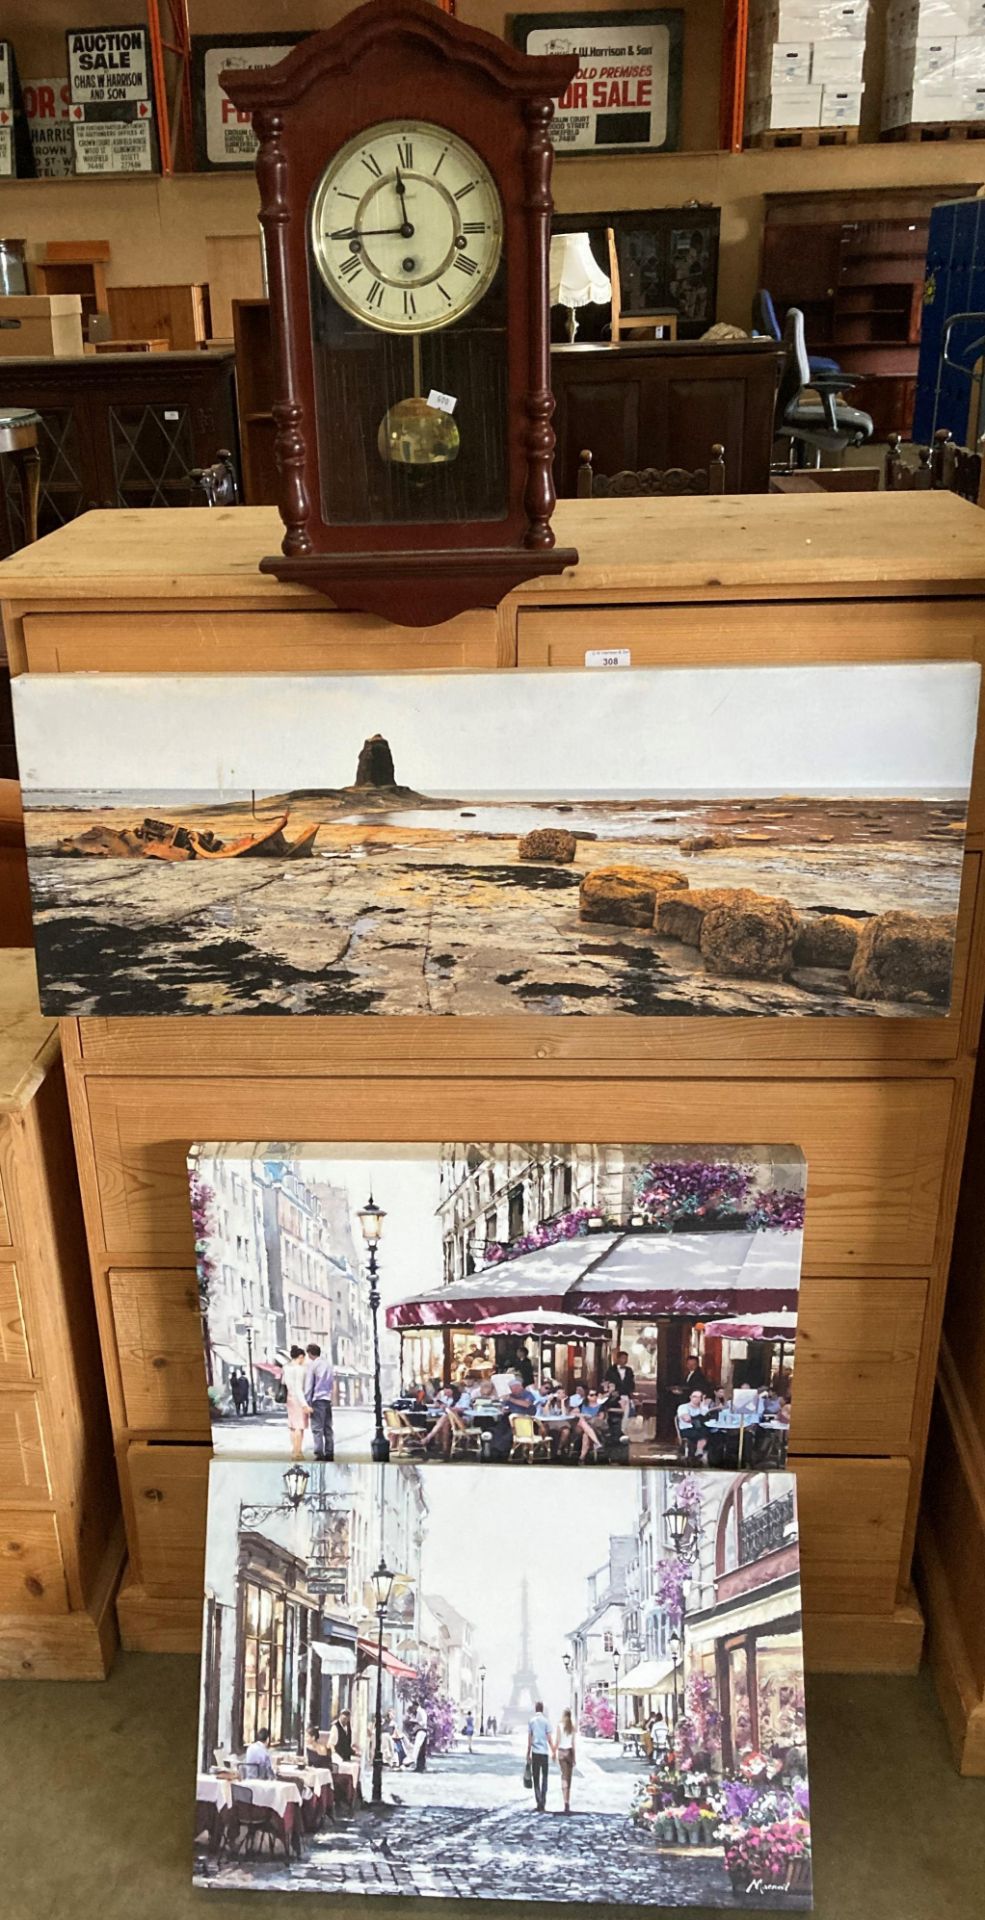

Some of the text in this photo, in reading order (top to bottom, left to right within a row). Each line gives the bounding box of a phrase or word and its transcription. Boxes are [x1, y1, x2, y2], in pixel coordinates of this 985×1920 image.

[73, 32, 142, 53] AUCTION
[628, 46, 634, 55] &
[636, 45, 653, 55] Son
[79, 52, 131, 70] SALE
[575, 65, 653, 79] OLD PREMISES
[106, 72, 143, 88] HARRISON
[23, 84, 55, 118] OR
[91, 88, 126, 100] AND SON
[558, 79, 652, 109] OR SALE
[31, 128, 71, 142] HARRIS
[35, 145, 66, 155] ROWN
[603, 658, 618, 666] 308
